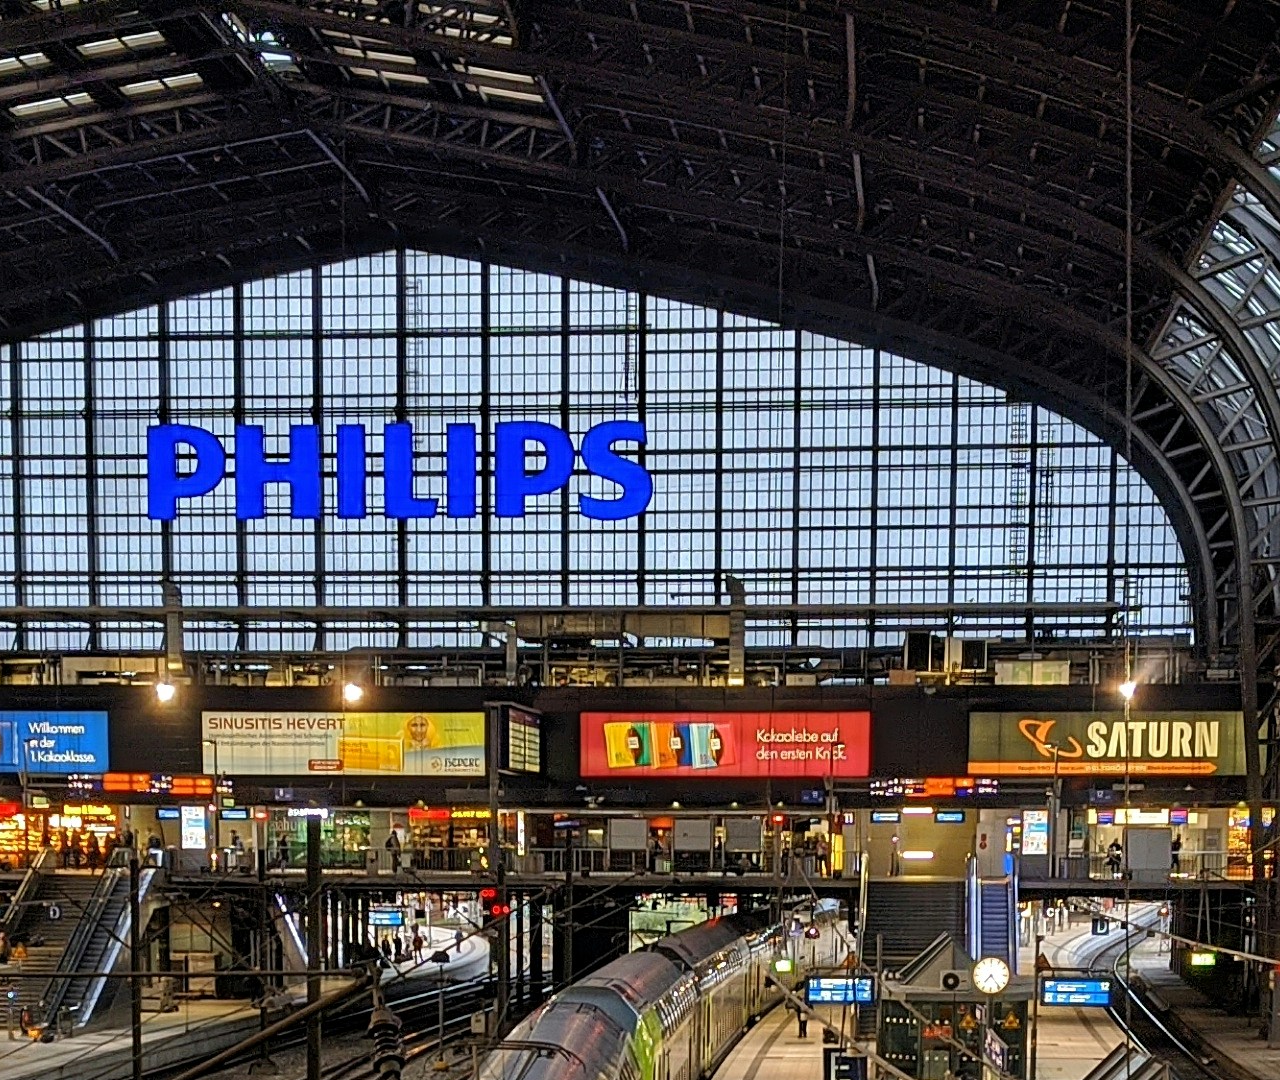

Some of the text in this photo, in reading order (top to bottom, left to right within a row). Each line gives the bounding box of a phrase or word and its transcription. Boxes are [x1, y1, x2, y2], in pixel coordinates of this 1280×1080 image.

[148, 421, 653, 521] PHILIPS
[28, 721, 85, 734] Willkommen
[208, 717, 345, 730] SINUSITIS HEVERT
[40, 735, 56, 748] der
[756, 727, 839, 743] Kakaoliebe auf
[1087, 721, 1219, 758] SATURN
[756, 745, 847, 760] den ersten Knck.
[49, 905, 60, 919] D
[1097, 921, 1108, 934] D
